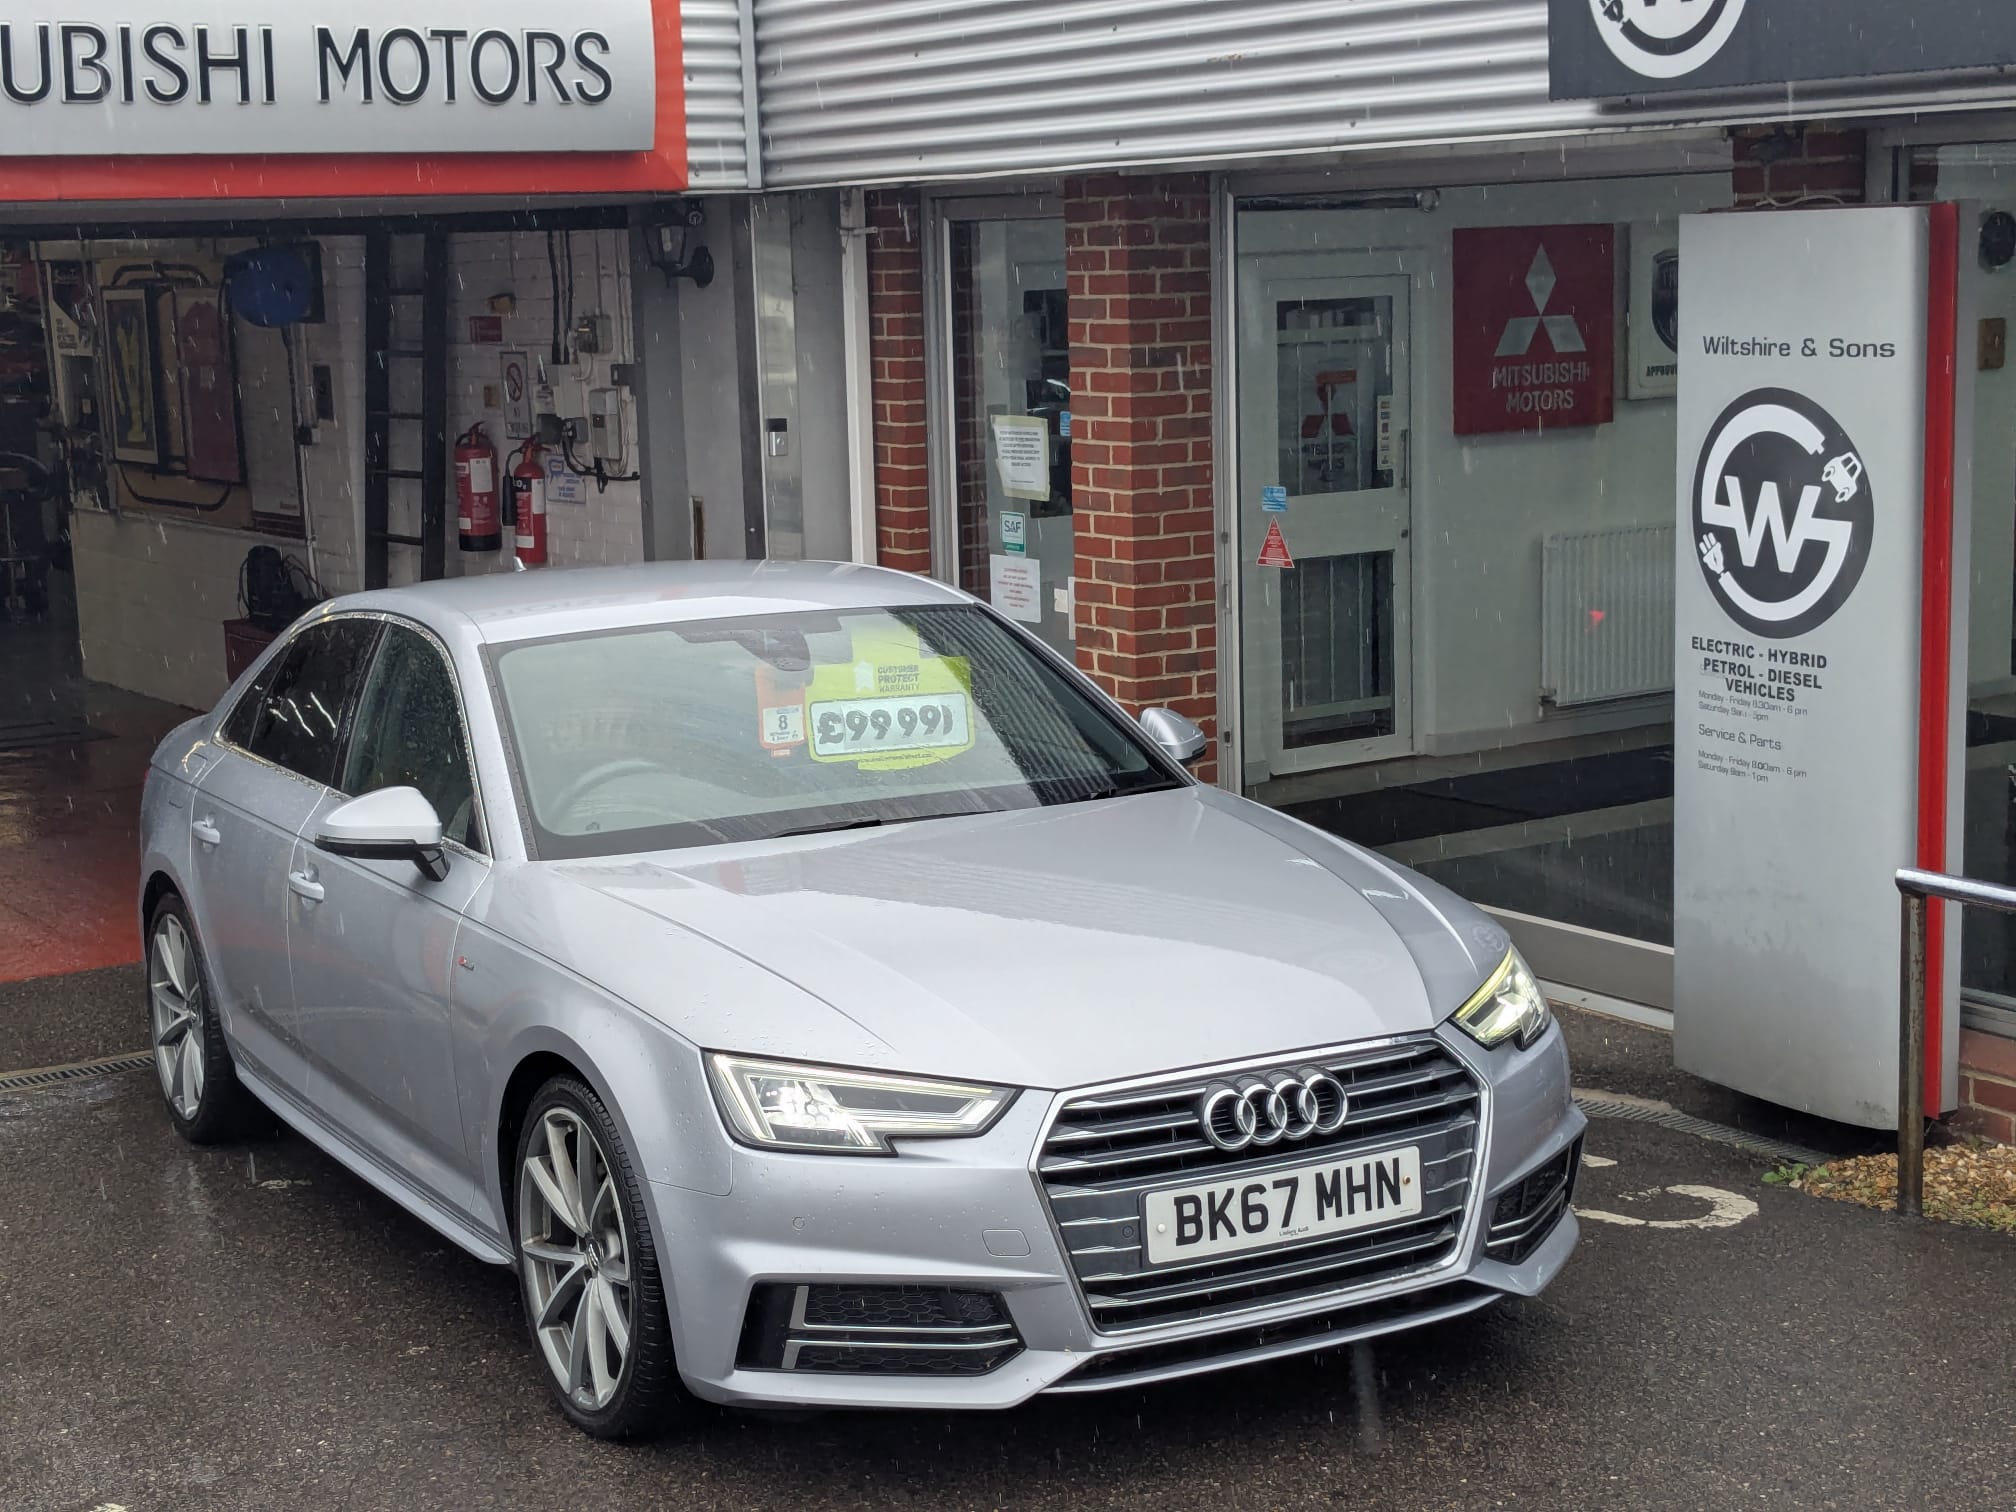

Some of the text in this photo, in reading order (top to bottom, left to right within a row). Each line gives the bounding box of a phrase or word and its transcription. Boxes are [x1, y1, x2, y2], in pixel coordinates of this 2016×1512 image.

[0, 22, 613, 105] UBISHI MOTORS
[1702, 335, 1896, 358] Wiltshire & Sons
[1493, 361, 1588, 388] MITSUBISHI
[1506, 389, 1574, 412] MOTORS
[1691, 636, 1755, 659] ELECTRIC
[1768, 648, 1827, 669] HYBRID
[878, 673, 920, 683] PROTECT
[1703, 657, 1755, 679] PETROL
[1768, 668, 1823, 689] DIESEL
[1725, 677, 1795, 701] VEHICLES
[779, 714, 788, 731] 8
[1698, 723, 1782, 750] Service & Parts
[1174, 1157, 1402, 1246] BK67 MHN
